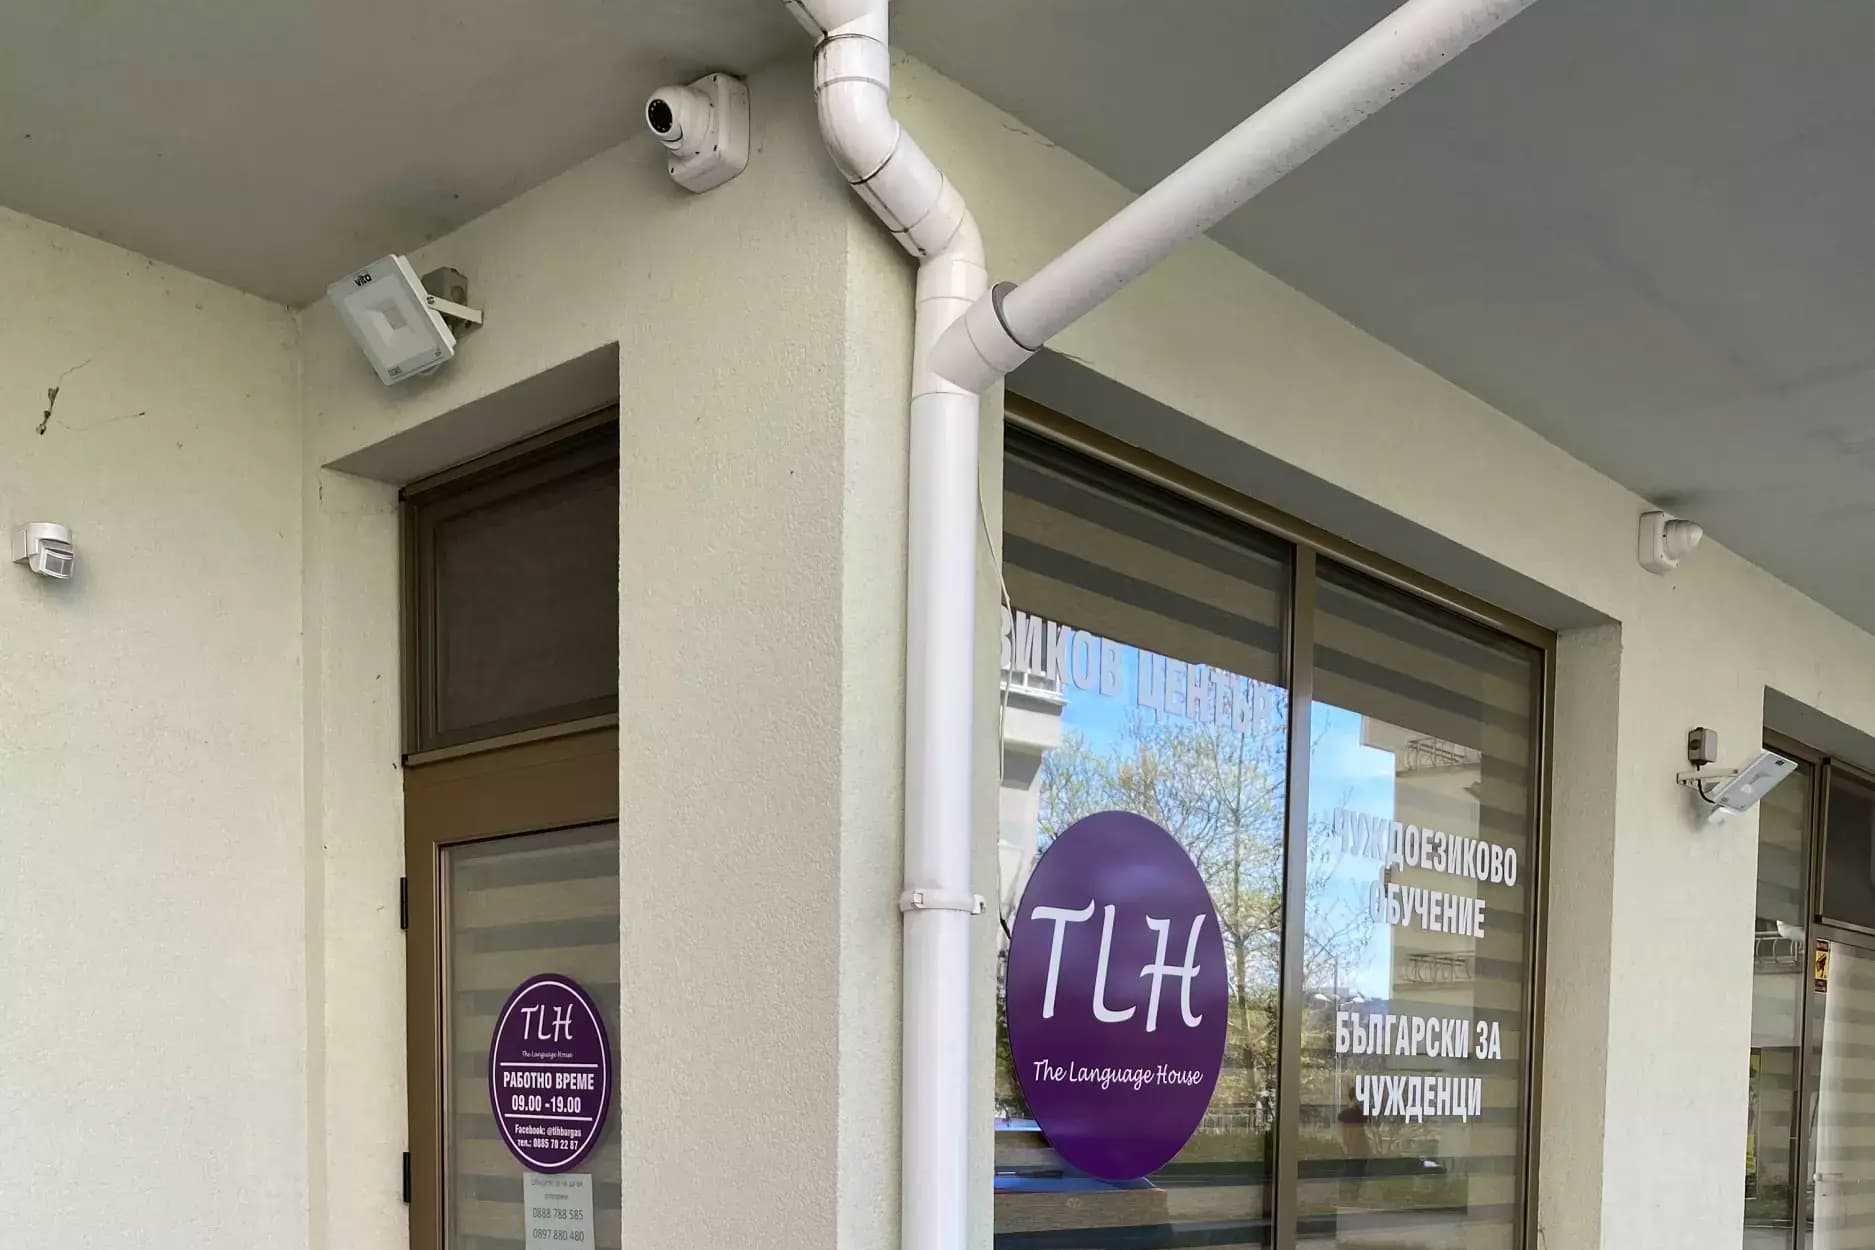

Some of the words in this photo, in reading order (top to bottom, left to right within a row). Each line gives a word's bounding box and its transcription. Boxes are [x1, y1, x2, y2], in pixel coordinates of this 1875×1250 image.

[1333, 808, 1517, 887] ЧУЖДОЕЗИКОВО
[1368, 878, 1486, 938] ОБУЧЕНИЕ
[1030, 899, 1206, 1033] TLH
[521, 1003, 573, 1042] TLH
[1335, 1011, 1470, 1058] БЪЛГАРСКИ
[1475, 1021, 1502, 1060] ЗА
[503, 1071, 552, 1089] РАБОТНО
[555, 1072, 595, 1090] ВРЕМЕ
[1033, 1059, 1066, 1082] The
[1069, 1061, 1154, 1091] Language
[1156, 1064, 1203, 1086] House
[511, 1094, 542, 1111] 09.00
[1355, 1075, 1482, 1123] ЧУЖДЕНЦИ
[515, 1123, 546, 1135] Facebook:
[533, 1138, 549, 1149] 0885
[550, 1139, 559, 1149] 70
[560, 1140, 569, 1150] 22
[568, 1208, 584, 1220] 585
[533, 1228, 552, 1240] 0897
